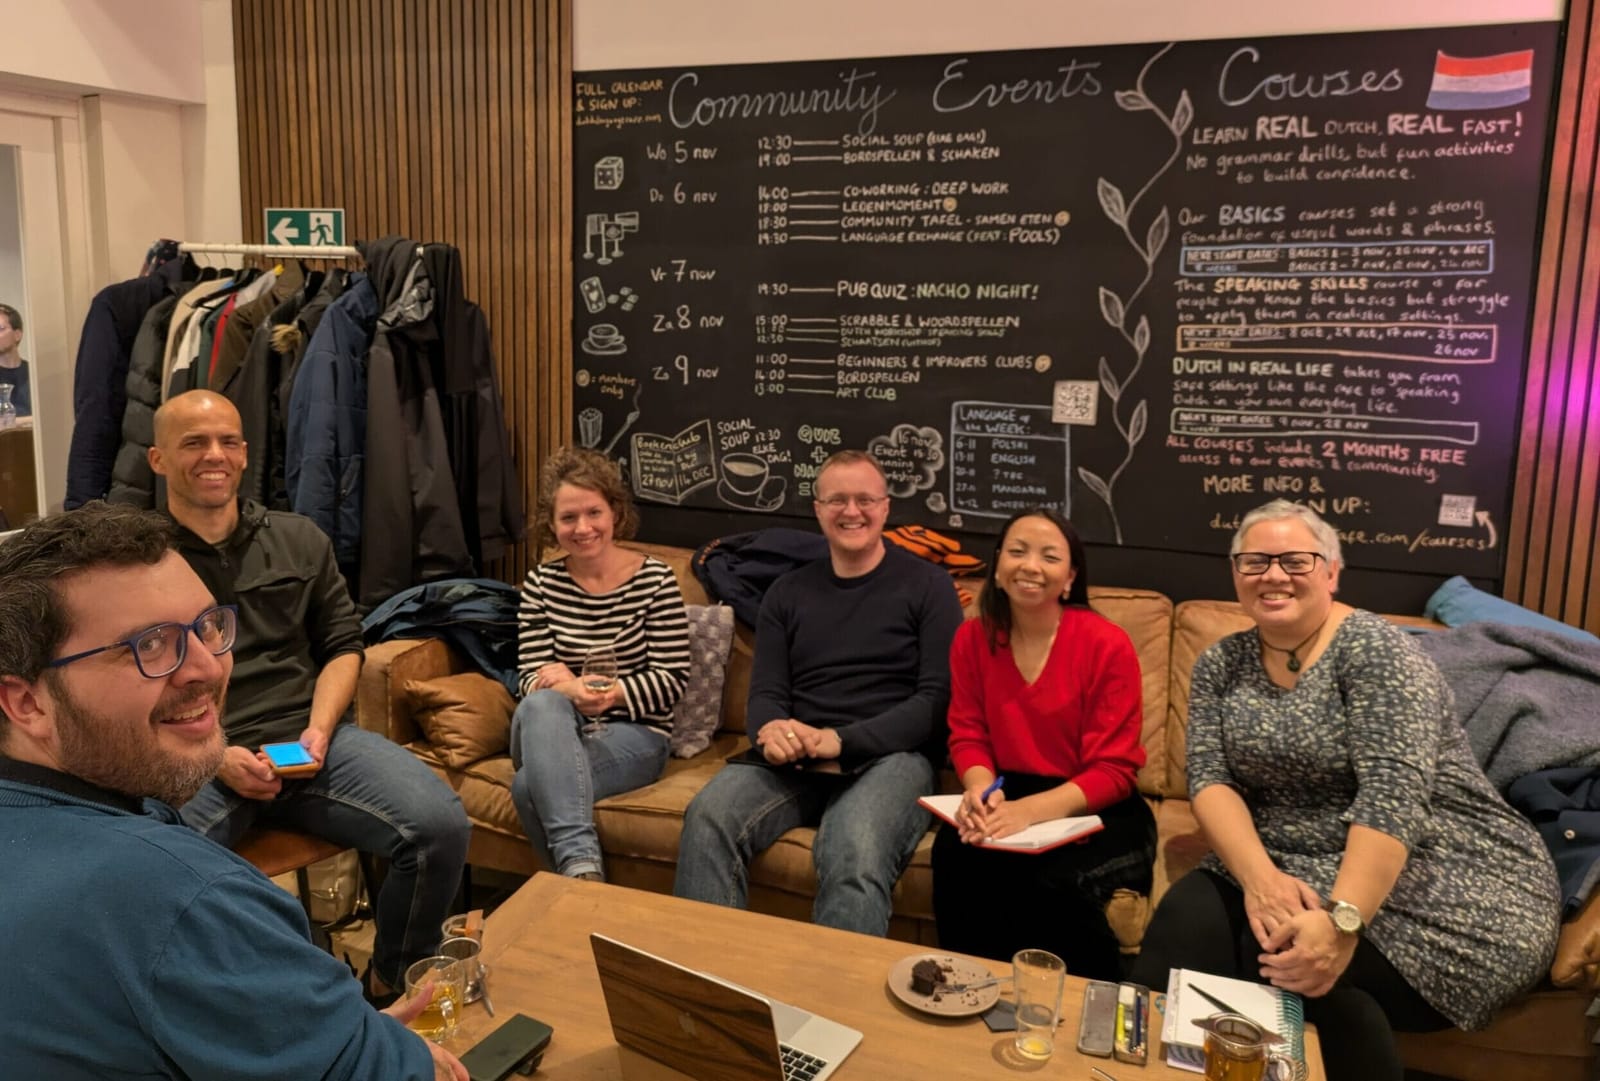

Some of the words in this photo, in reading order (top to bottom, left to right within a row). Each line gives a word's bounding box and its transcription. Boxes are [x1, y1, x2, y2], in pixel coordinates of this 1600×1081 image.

[1218, 46, 1405, 106] Courses
[576, 82, 606, 96] FULL
[611, 79, 663, 94] CALENDAR
[589, 98, 618, 111] SIGN
[668, 68, 897, 137] Community
[932, 58, 1102, 112] Events
[1193, 127, 1249, 145] LEARN
[1255, 115, 1318, 141] REAL
[1387, 112, 1454, 136] REAL
[1462, 111, 1523, 137] FAST!
[758, 135, 793, 150] 12:30
[842, 134, 890, 147] SOCIAL
[893, 133, 925, 146] SOUP
[647, 143, 667, 160] Wo
[674, 141, 688, 163] 5
[693, 147, 718, 160] nov
[758, 153, 792, 167] 19:00
[843, 149, 921, 164] BORDSPELLEN
[927, 149, 936, 162] &
[941, 146, 1000, 162] SCHAKEN
[1186, 154, 1208, 172] No
[1216, 151, 1293, 175] grammar
[1298, 143, 1351, 163] drills,
[1357, 143, 1389, 160] but
[1396, 144, 1430, 163] fun
[1434, 140, 1515, 157] activities
[1236, 169, 1252, 184] to
[1263, 166, 1309, 182] build
[1316, 165, 1416, 182] confidence.
[650, 188, 664, 202] Do
[673, 182, 686, 204] 6
[693, 191, 718, 203] nov
[932, 181, 968, 195] DEEP
[971, 182, 1009, 195] WORK
[842, 199, 943, 213] LEDENMOMENT
[1178, 207, 1208, 226] Our
[1218, 204, 1287, 225] BASICS
[1298, 207, 1356, 221] courses
[1369, 200, 1397, 218] set
[1427, 200, 1484, 220] strong
[841, 215, 915, 228] COMMUNITY
[921, 214, 963, 227] TAFEL
[975, 213, 1017, 226] SAMEN
[1019, 213, 1052, 225] ETEN
[841, 231, 905, 243] LANGUAGE
[907, 230, 964, 243] EXCHANGE
[1009, 226, 1061, 245] POOLS)
[1270, 229, 1286, 242] of
[1290, 224, 1336, 241] useful
[1345, 223, 1393, 237] words
[1401, 222, 1414, 237] &
[1423, 220, 1496, 236] phrases.
[650, 266, 667, 282] Vr
[671, 259, 687, 282] 7
[689, 268, 716, 281] nov
[837, 280, 869, 297] PUB
[916, 283, 971, 299] NACHO
[976, 284, 1040, 300] NIGHT!
[1174, 278, 1205, 292] The
[1214, 277, 1302, 293] SPEAKING
[1309, 277, 1369, 290] SKILLS
[1373, 278, 1420, 289] course
[1455, 278, 1488, 290] for
[1176, 296, 1219, 310] people
[1226, 294, 1256, 305] who
[1264, 294, 1302, 305] know
[1311, 292, 1336, 305] the
[1344, 292, 1396, 306] basics
[1406, 291, 1435, 305] but
[1441, 292, 1510, 314] struggle
[652, 314, 674, 332] Za
[676, 304, 692, 329] 8
[699, 315, 724, 328] nov
[755, 315, 788, 326] 15:00
[839, 314, 900, 327] SCRABBLE
[904, 314, 914, 327] &
[918, 315, 1020, 328] WOORDSPELLEN
[1178, 312, 1195, 322] to
[1205, 308, 1247, 325] apply
[1254, 308, 1297, 321] them
[1305, 308, 1321, 321] in
[1326, 308, 1386, 320] realistic
[840, 336, 899, 347] SCHAATSEN
[1433, 343, 1453, 356] 26
[1453, 347, 1480, 357] nov
[674, 355, 689, 385] 9
[696, 367, 719, 379] nov
[755, 353, 788, 365] 11:00
[837, 353, 907, 368] BEGINNERS
[912, 355, 920, 368] &
[926, 355, 988, 368] IMPROVERS
[995, 355, 1033, 369] CLUBS
[837, 370, 920, 385] BORDSPELLEN
[1172, 356, 1223, 375] DUTCH
[1227, 360, 1246, 373] IN
[1249, 360, 1293, 376] REAL
[1295, 361, 1334, 378] LIFE
[1343, 365, 1381, 379] takes
[1387, 371, 1413, 387] you
[1418, 372, 1461, 385] from
[836, 387, 861, 398] ART
[864, 386, 897, 401] CLUB
[1173, 393, 1208, 405] Dutch
[1213, 394, 1228, 405] in
[1266, 398, 1293, 407] own
[1208, 379, 1259, 396] settings
[1303, 380, 1327, 393] the
[1370, 384, 1386, 396] to
[1396, 384, 1460, 404] speaking
[960, 406, 1017, 421] LANGUAGE
[717, 418, 756, 434] SOCIAL
[720, 431, 750, 450] SOUP
[752, 442, 777, 454] ELKE
[767, 449, 792, 463] DAG!
[990, 453, 1036, 464] ENGLISH
[1166, 434, 1190, 448] ALL
[1193, 436, 1255, 452] COURSES
[1263, 438, 1312, 454] include
[1321, 441, 1337, 457] 2
[1343, 441, 1411, 461] MONTHS
[1419, 447, 1467, 466] FREE
[692, 466, 711, 480] DEC
[1178, 454, 1221, 466] access
[1228, 454, 1243, 465] to
[1249, 456, 1272, 466] our
[1278, 454, 1324, 469] events
[1331, 458, 1341, 470] &
[1347, 460, 1439, 484] community
[991, 484, 1047, 495] MANDARIN
[1203, 473, 1255, 495] MORE
[1263, 475, 1303, 493] INFO
[1308, 476, 1325, 494] &
[1332, 496, 1371, 514] UP:
